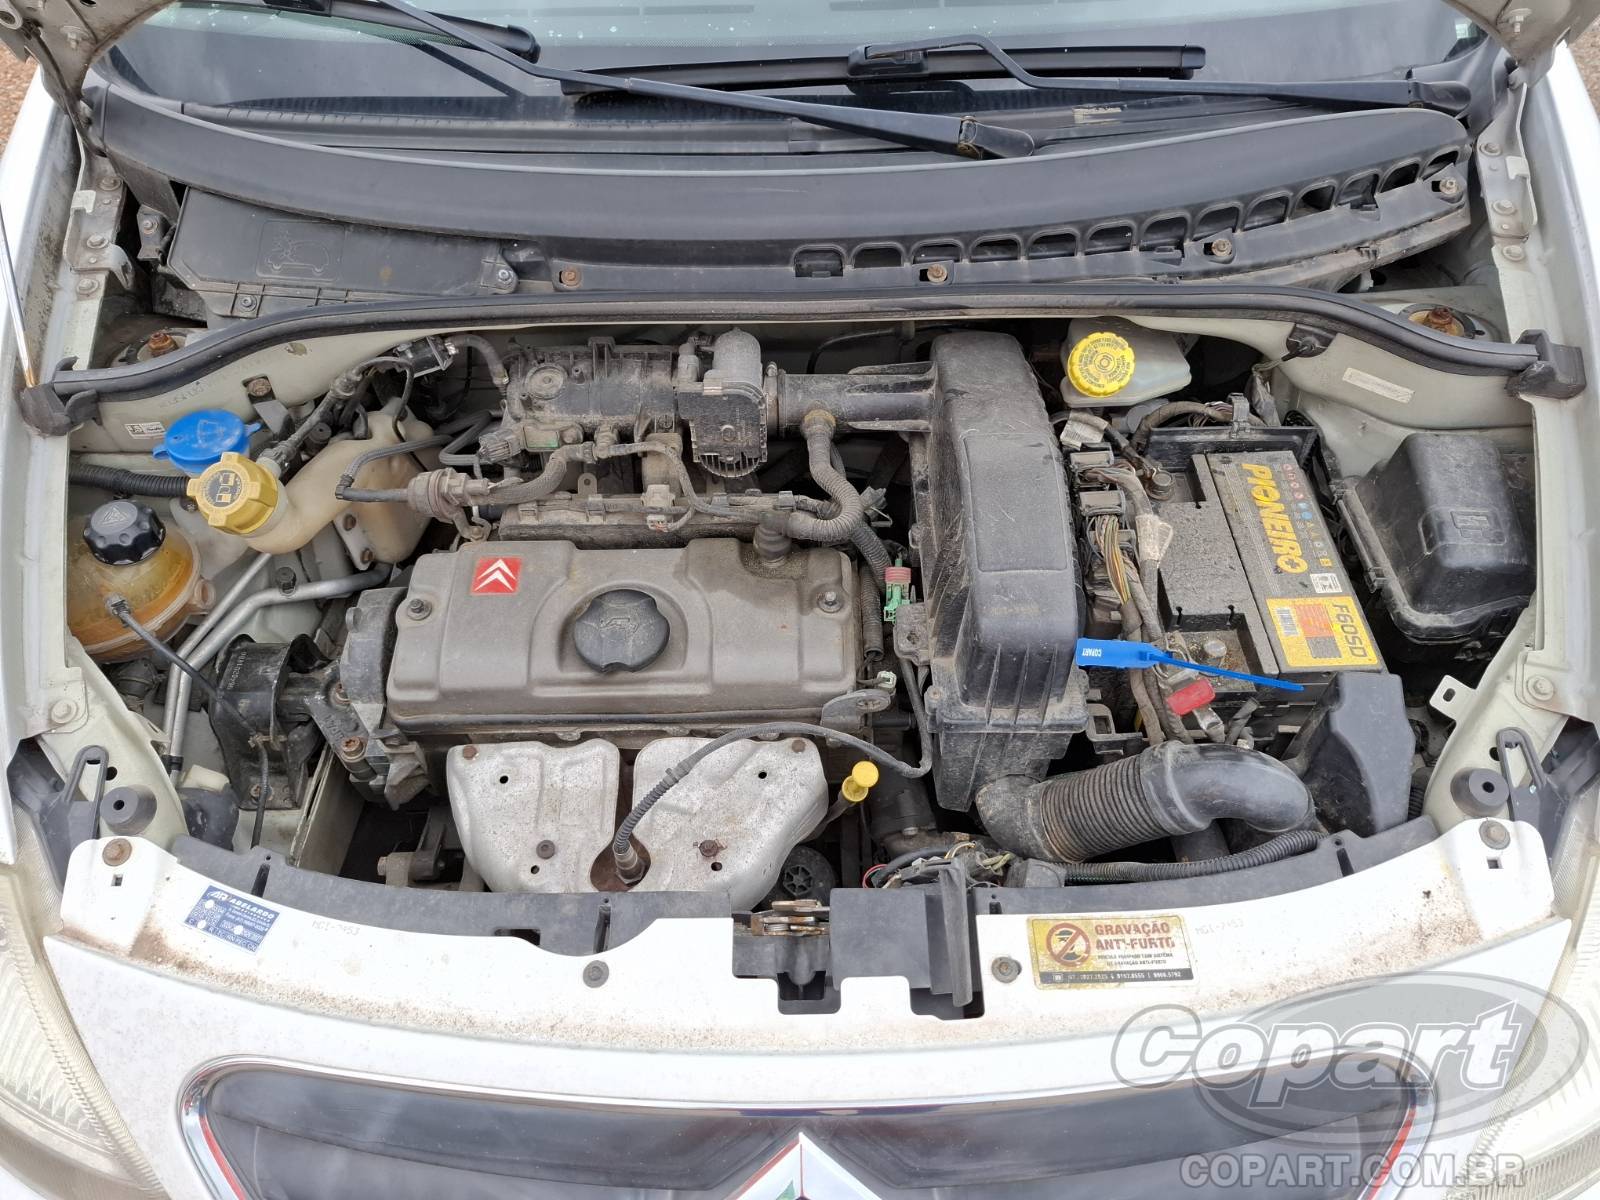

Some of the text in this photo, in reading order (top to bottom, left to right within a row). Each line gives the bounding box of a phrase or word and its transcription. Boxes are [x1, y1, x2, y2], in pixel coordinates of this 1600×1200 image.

[1242, 463, 1308, 573] PIONEIRO
[1081, 647, 1102, 657] COPART
[1094, 920, 1171, 938] GRAVAÇÃO
